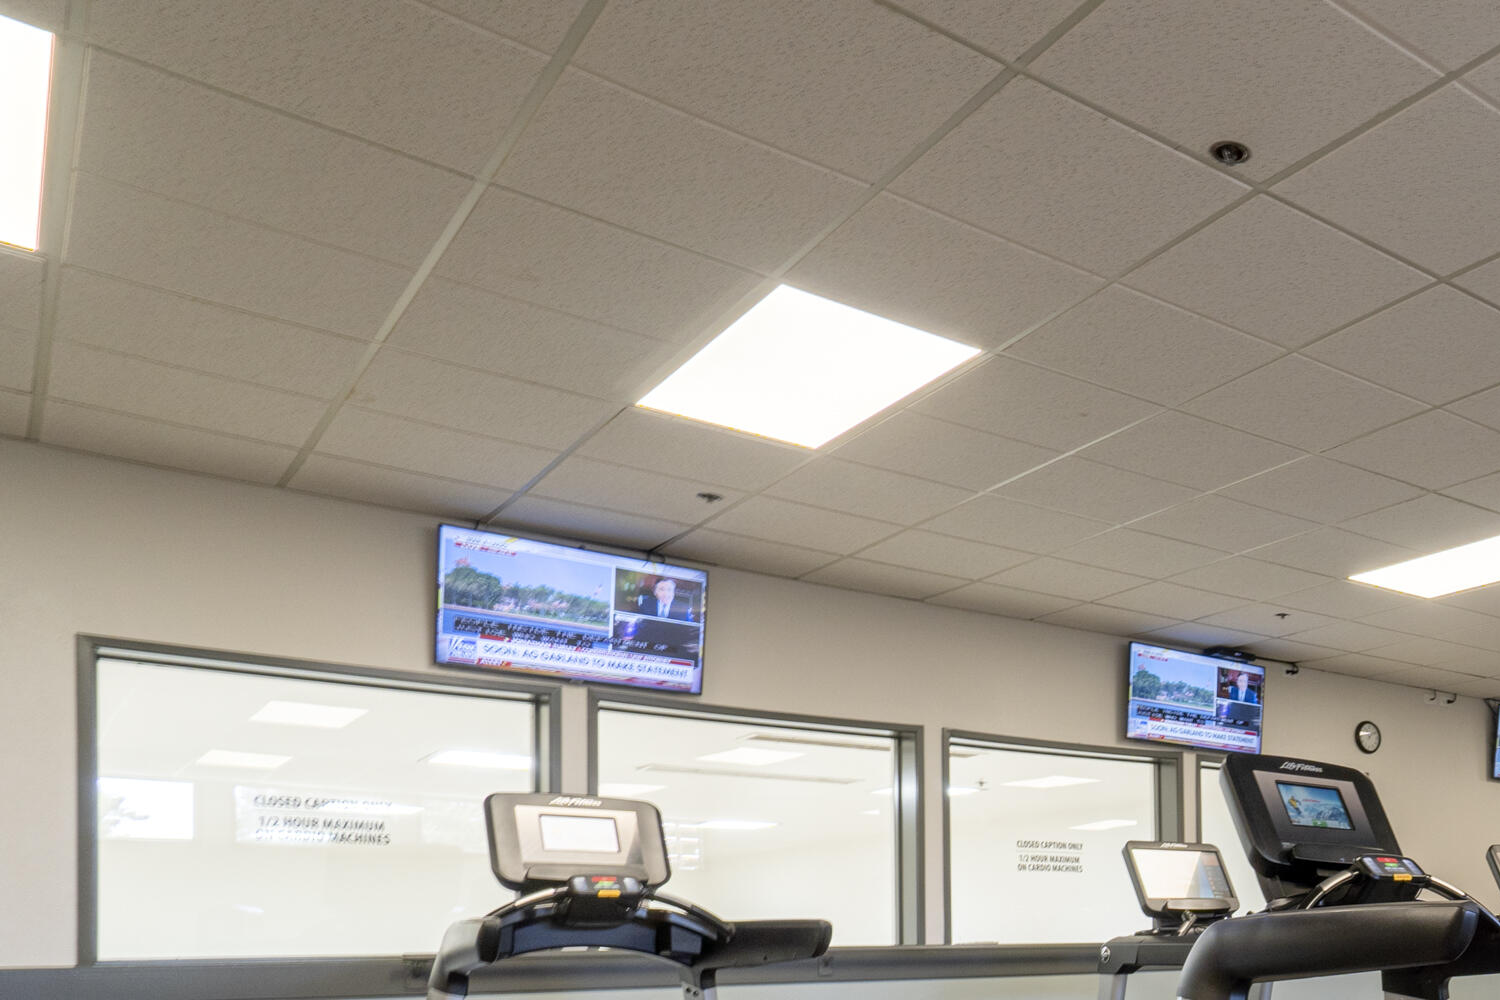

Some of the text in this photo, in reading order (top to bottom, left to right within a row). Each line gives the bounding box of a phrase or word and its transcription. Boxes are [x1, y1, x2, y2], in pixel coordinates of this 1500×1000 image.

[254, 794, 302, 809] CLOSED
[258, 815, 385, 831] 1/2 HOUR MAXIMUM
[328, 830, 392, 846] MACHINES
[1016, 840, 1084, 850] CLOSED CAPTION ONLY
[1018, 854, 1080, 864] 1/2 HOUR MAXIMUM
[1017, 863, 1083, 873] ON CARDIO MACHINES
